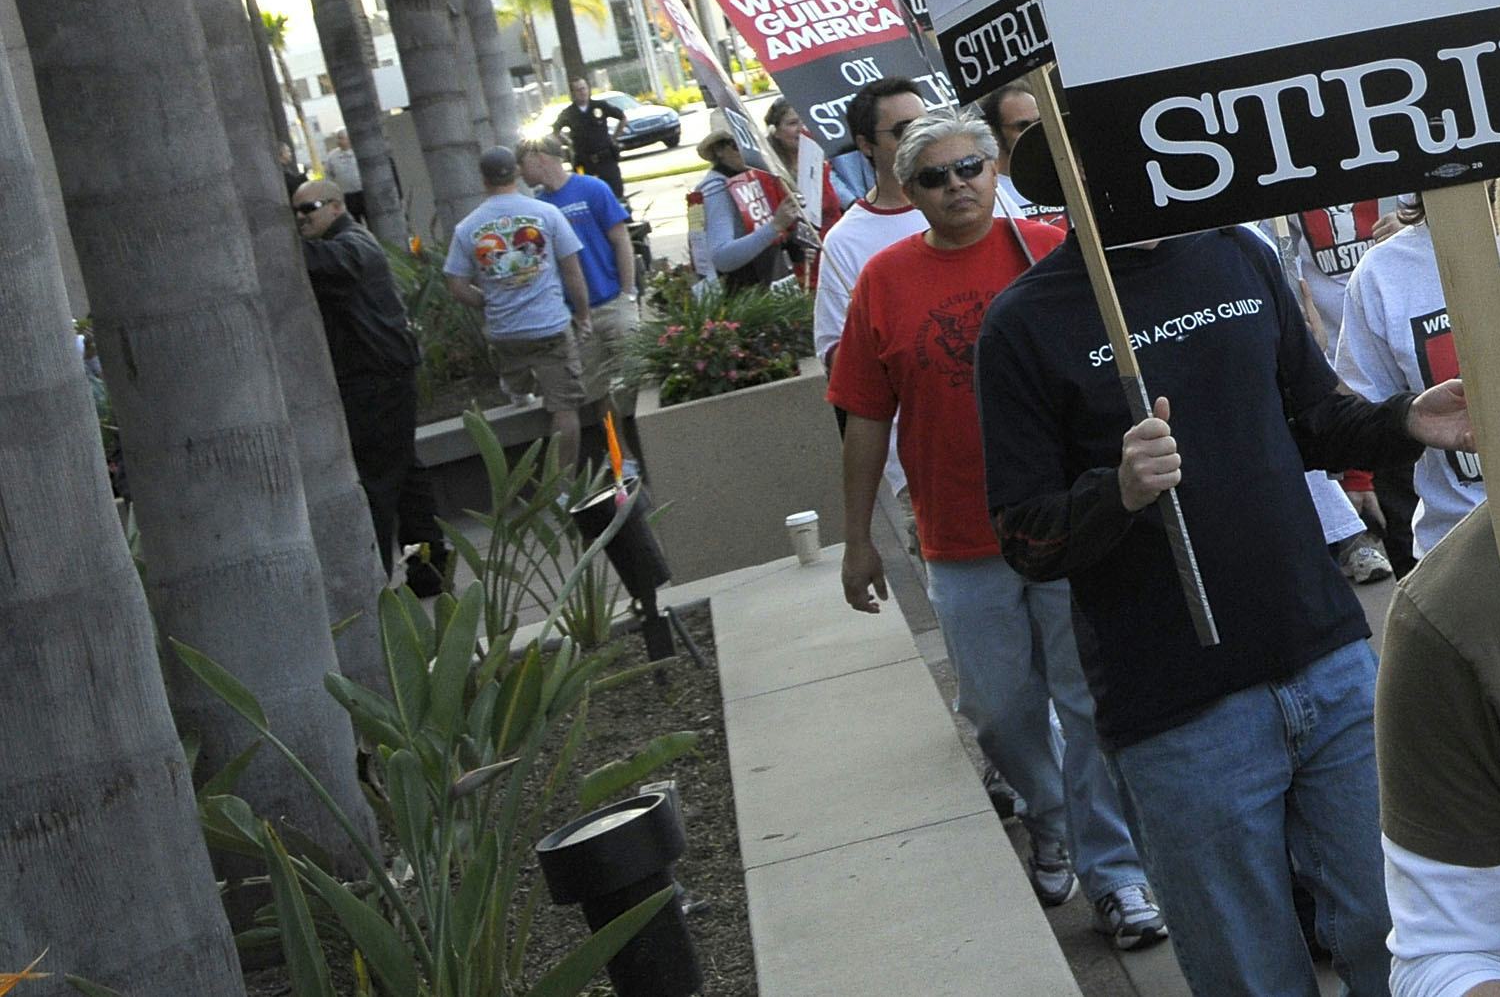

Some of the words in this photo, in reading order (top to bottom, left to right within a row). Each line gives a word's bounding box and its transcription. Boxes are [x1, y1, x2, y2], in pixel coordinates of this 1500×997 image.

[767, 8, 904, 60] AMERICA
[840, 57, 883, 86] ON
[1316, 249, 1338, 273] ON
[1089, 330, 1151, 368] SCEN
[1154, 308, 1216, 343] ACTORS
[1422, 313, 1451, 334] WR
